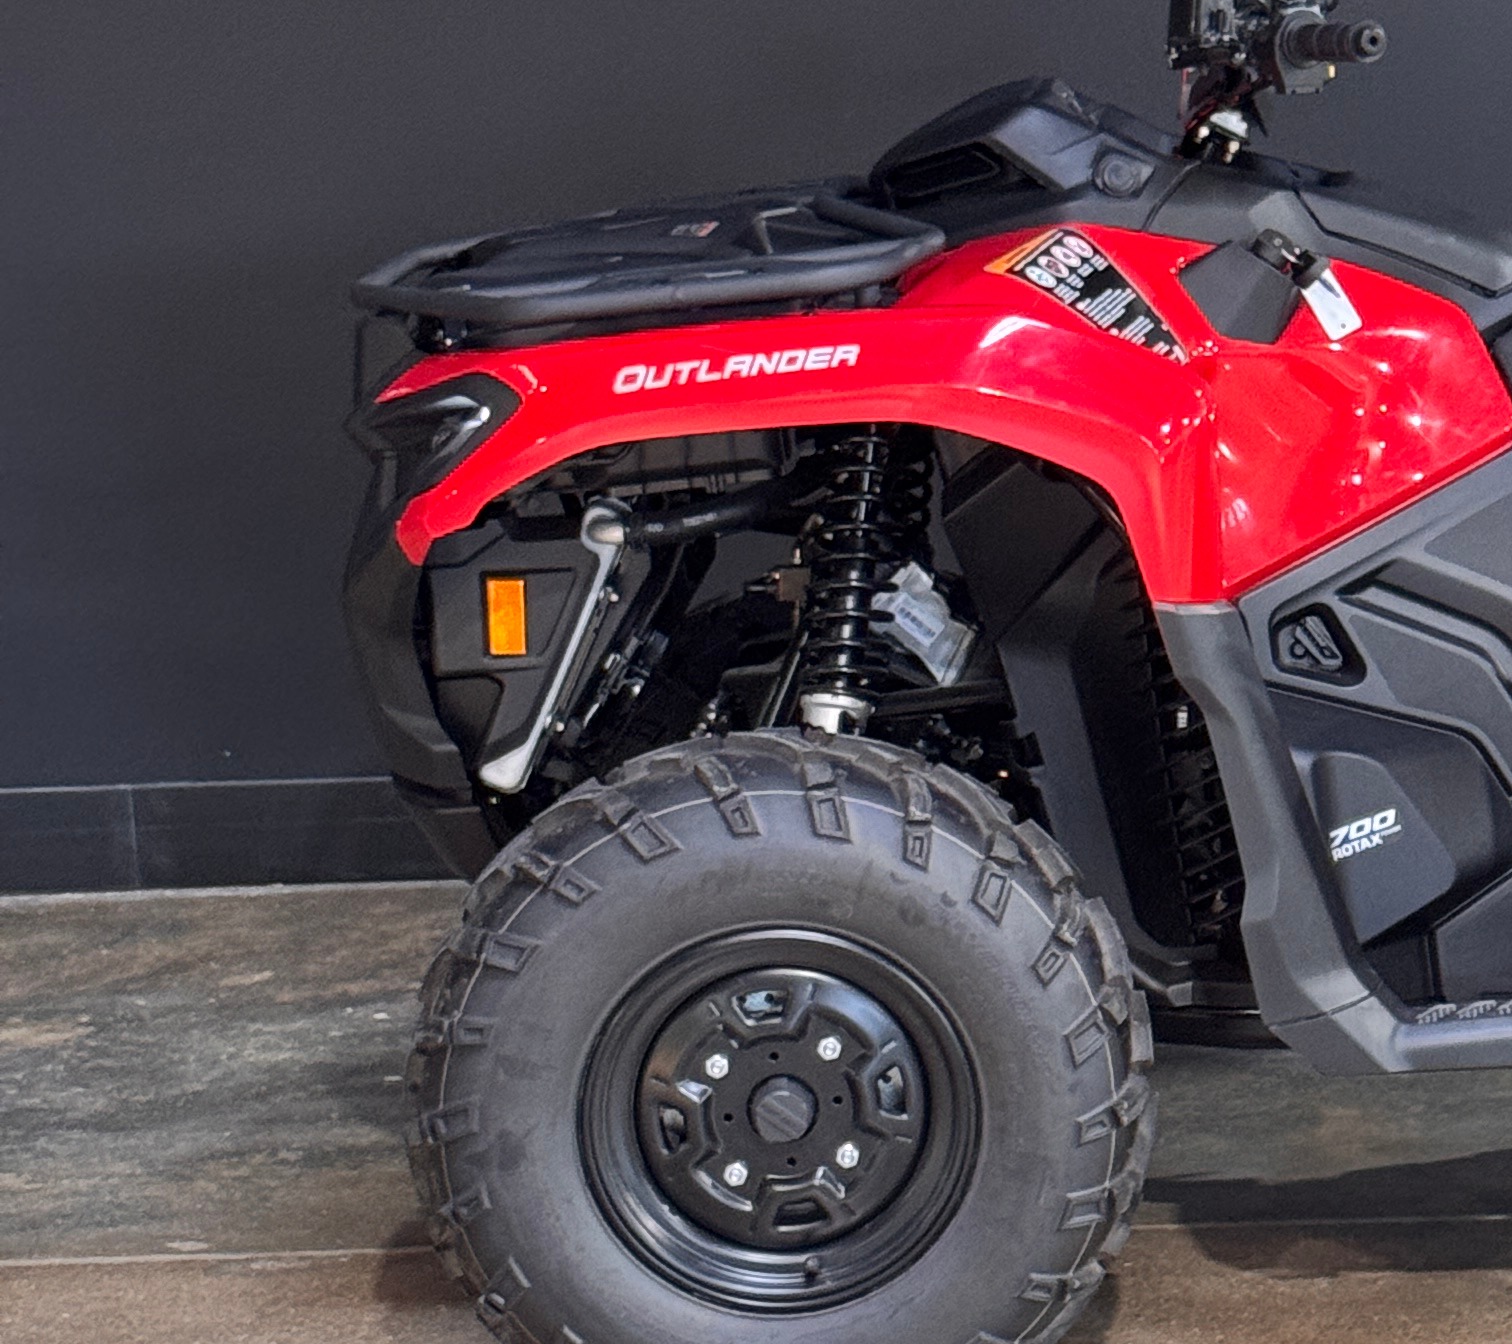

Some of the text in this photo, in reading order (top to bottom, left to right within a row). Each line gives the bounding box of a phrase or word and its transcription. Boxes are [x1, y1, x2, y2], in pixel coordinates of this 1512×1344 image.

[613, 343, 860, 394] OUTLANDER
[1329, 808, 1396, 848] 700
[1331, 832, 1384, 862] ROTAX
